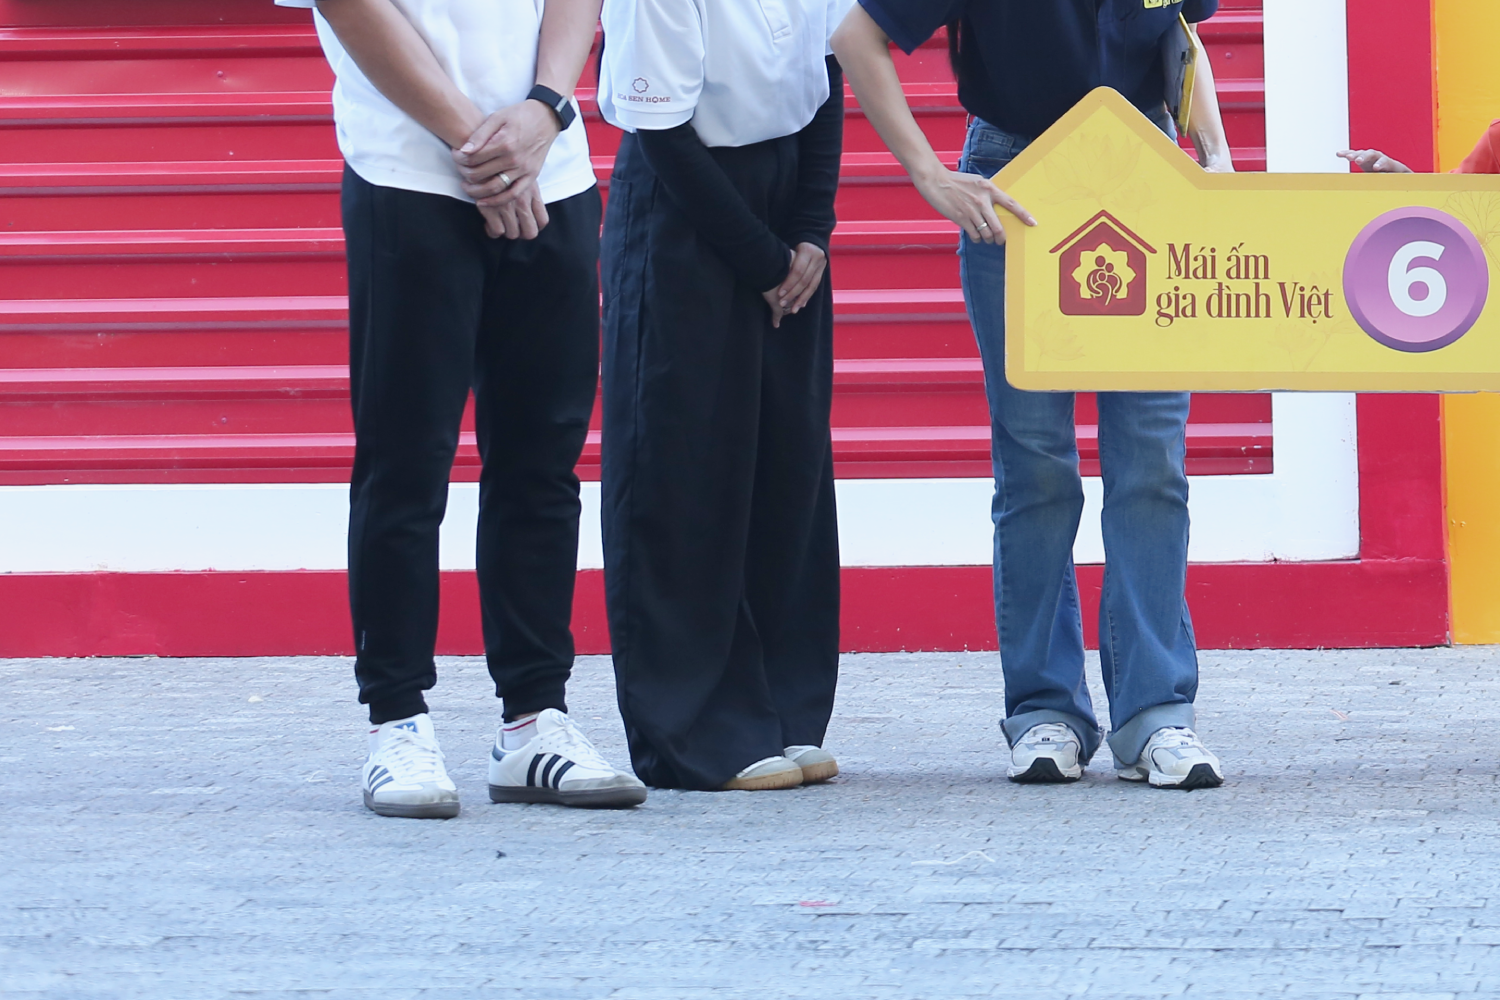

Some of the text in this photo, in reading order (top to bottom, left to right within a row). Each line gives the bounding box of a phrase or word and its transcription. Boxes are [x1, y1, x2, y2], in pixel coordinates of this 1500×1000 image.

[1165, 242, 1271, 280] Mái ấm
[1387, 240, 1448, 317] 6
[1155, 281, 1335, 328] gia đình Việt
